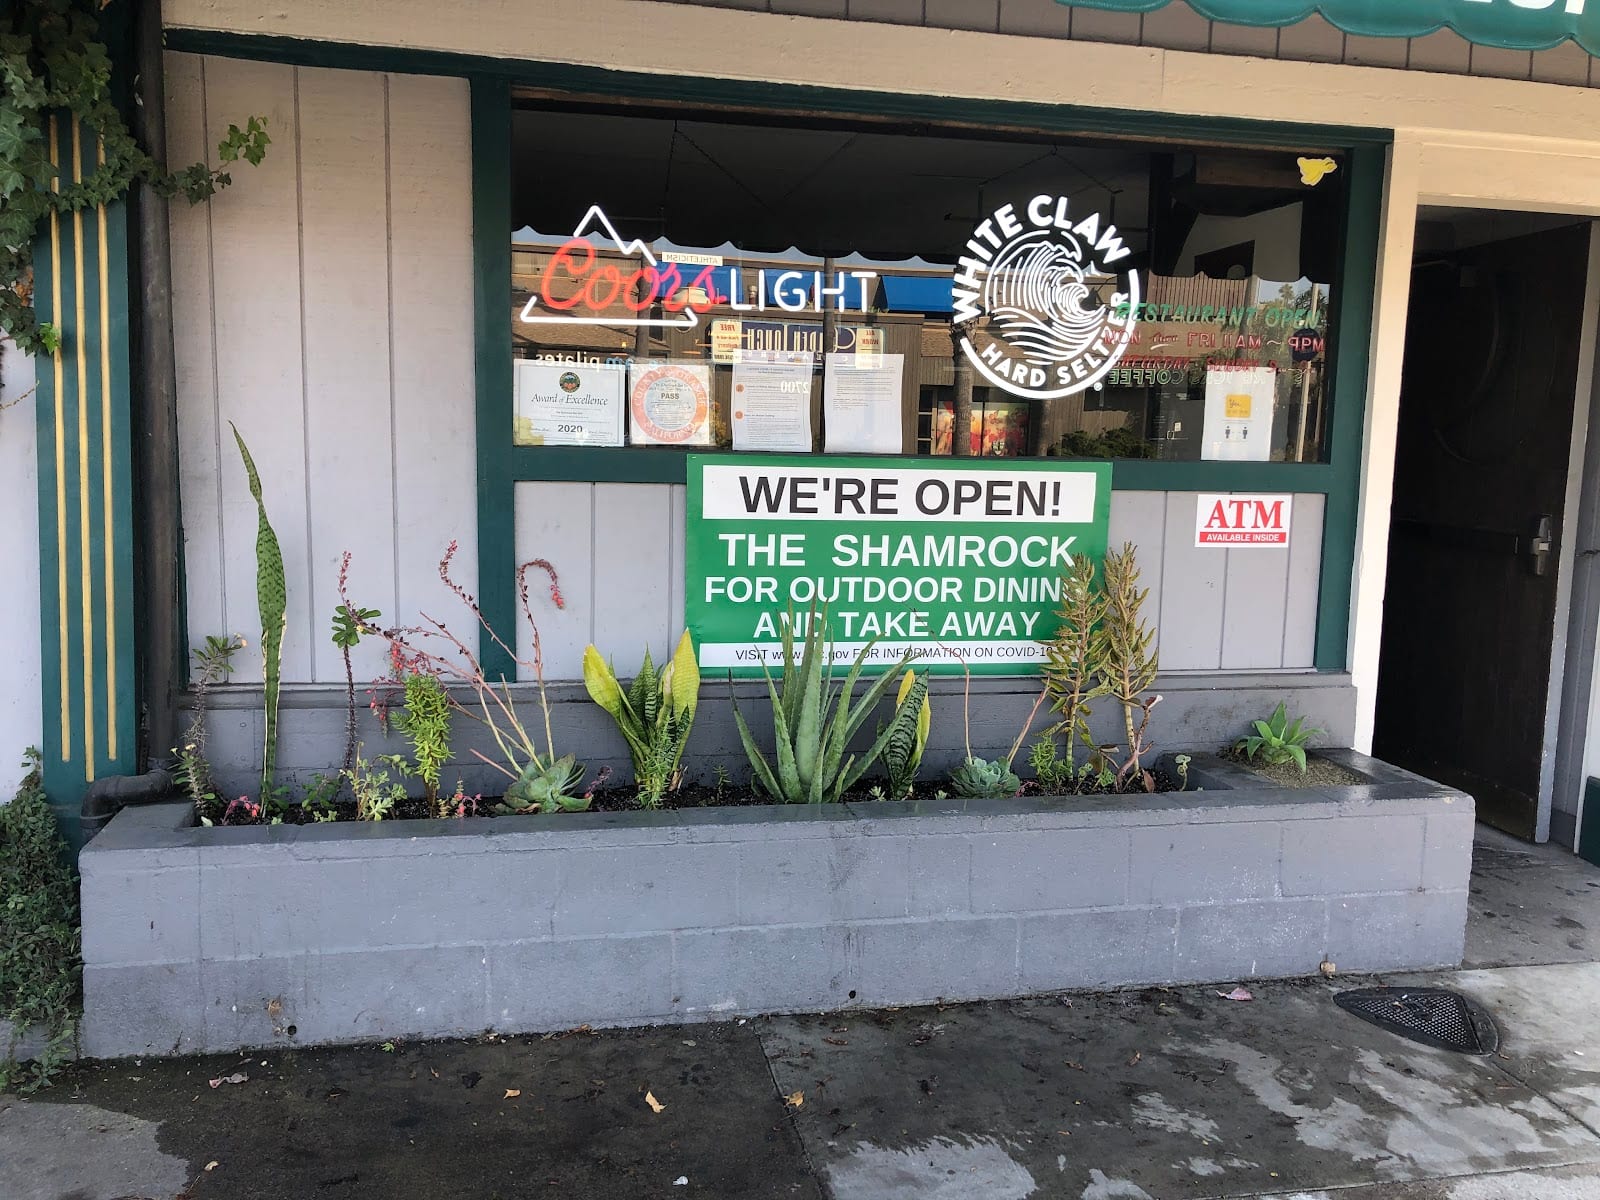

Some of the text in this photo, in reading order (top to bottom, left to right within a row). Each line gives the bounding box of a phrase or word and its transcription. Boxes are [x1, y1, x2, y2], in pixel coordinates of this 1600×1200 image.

[951, 194, 1131, 325] WHITE CLAW
[541, 238, 878, 313] Coors LIGHT
[1115, 302, 1321, 330] RESTAURANT OPEN
[1187, 332, 1215, 347] FRI
[981, 342, 1046, 388] HARD
[531, 393, 557, 404] Award
[565, 394, 609, 406] Excellence
[660, 392, 680, 400] PASS
[557, 424, 583, 433] 2020
[738, 475, 1061, 517] WE'RE OPEN!
[1203, 499, 1285, 529] ATM
[718, 533, 1079, 569] THE SHAMROCK
[1206, 534, 1280, 542] AVAILABLE INSIDE
[705, 576, 777, 603] FOR
[789, 576, 964, 603] OUTDOOR
[838, 611, 929, 638] TAKE
[938, 611, 1041, 637] AWAY
[735, 649, 768, 660] VISIT
[853, 648, 879, 659] FOR
[883, 647, 971, 659] INFORMATION
[975, 647, 993, 657] ON
